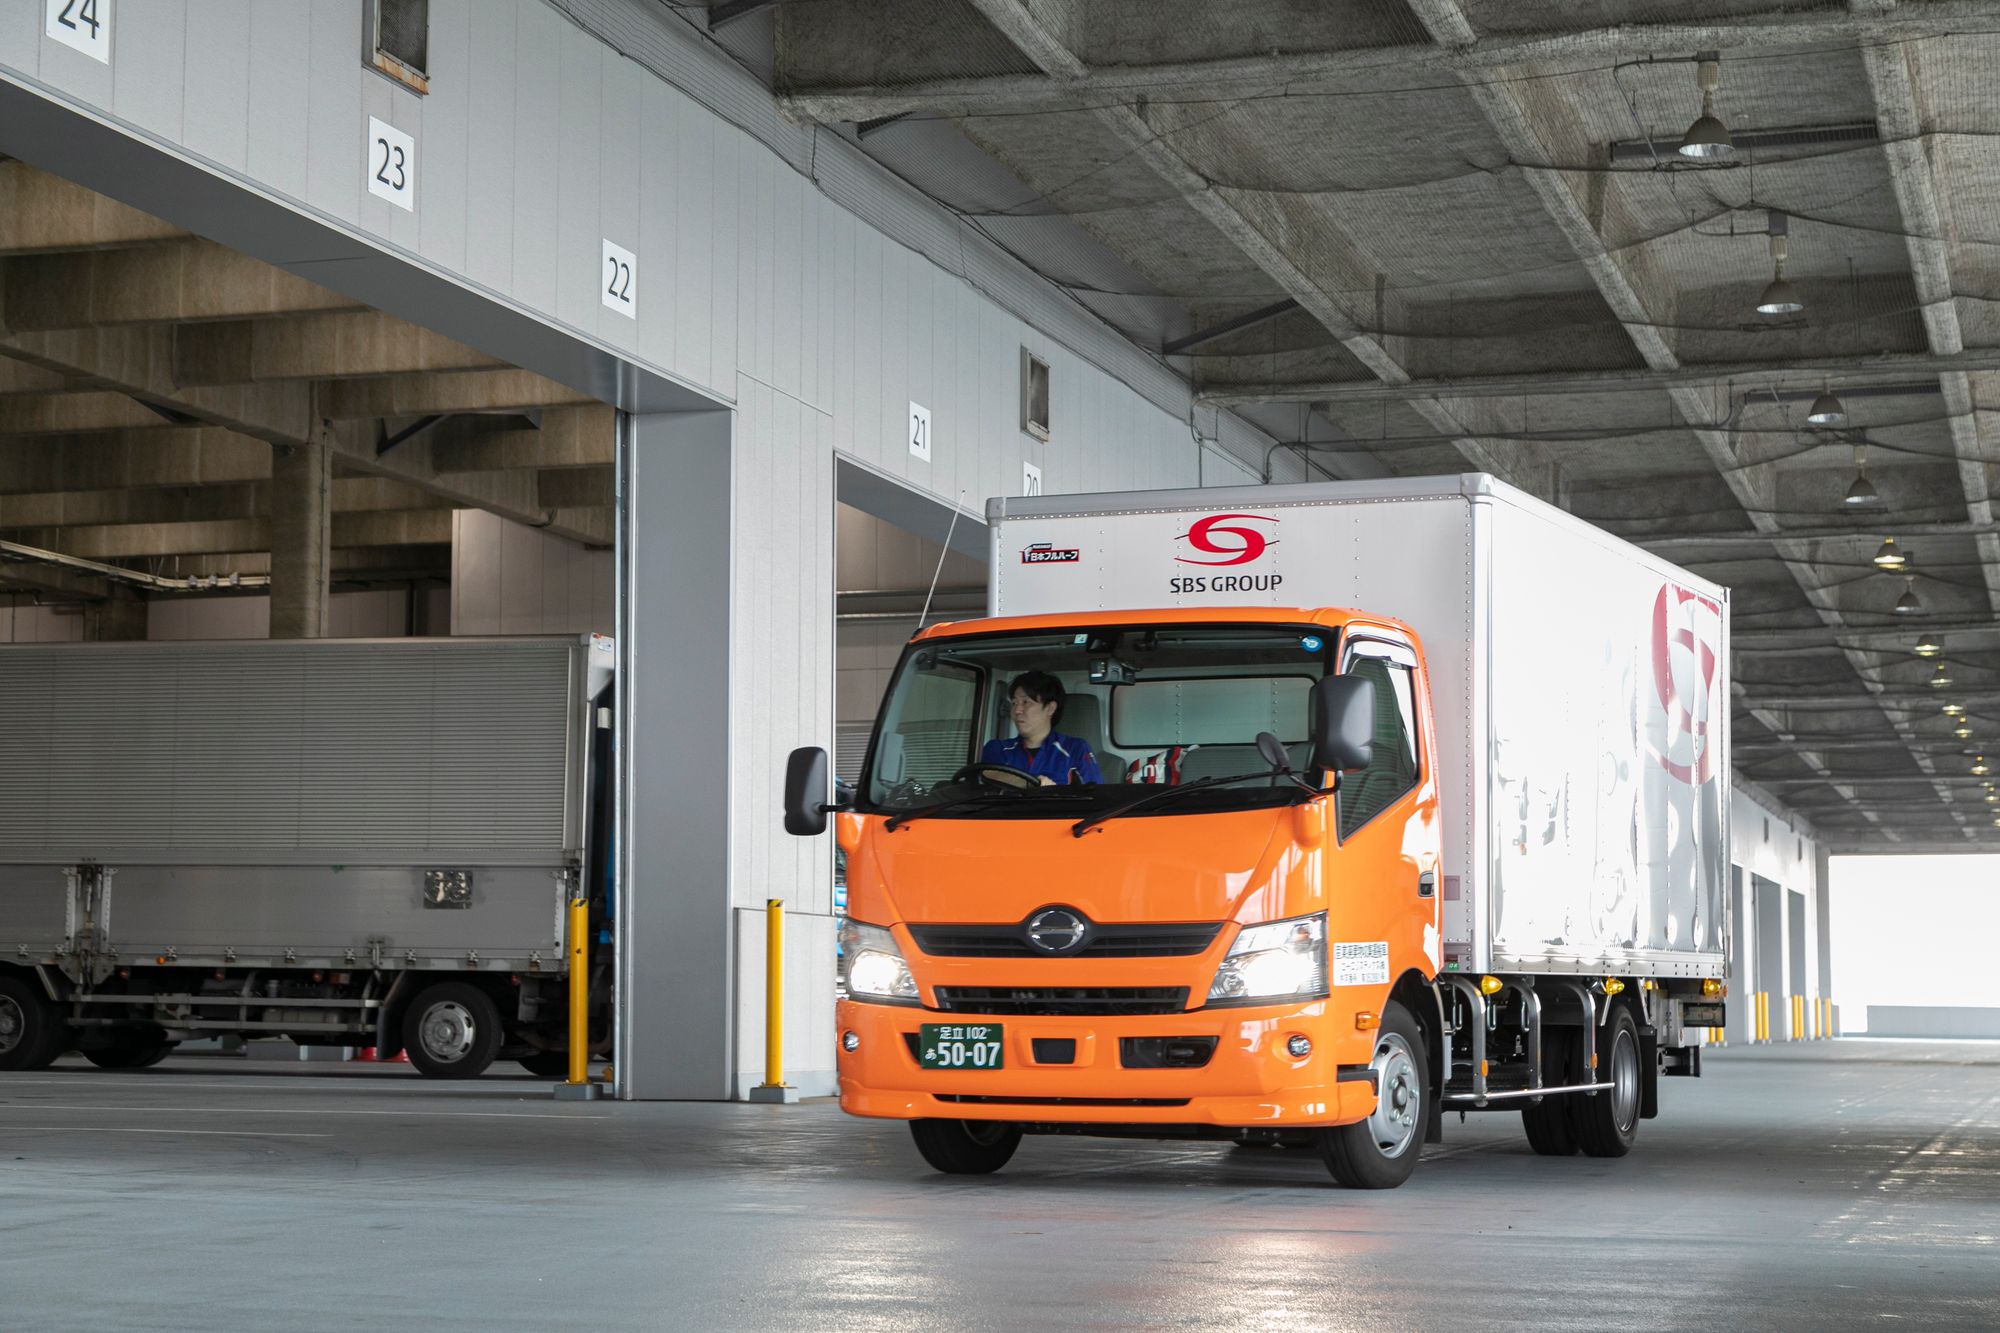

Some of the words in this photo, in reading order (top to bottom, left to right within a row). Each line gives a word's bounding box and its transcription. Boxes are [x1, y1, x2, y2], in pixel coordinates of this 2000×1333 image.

[376, 138, 405, 191] 23
[608, 256, 630, 303] 22
[912, 414, 927, 449] 21
[1030, 551, 1078, 562] 日本フルハーフ
[1170, 577, 1206, 593] SBS
[1211, 574, 1283, 592] GROUP
[939, 1026, 965, 1040] 足立
[966, 1026, 988, 1040] 102
[937, 1042, 1001, 1067] 50-07
